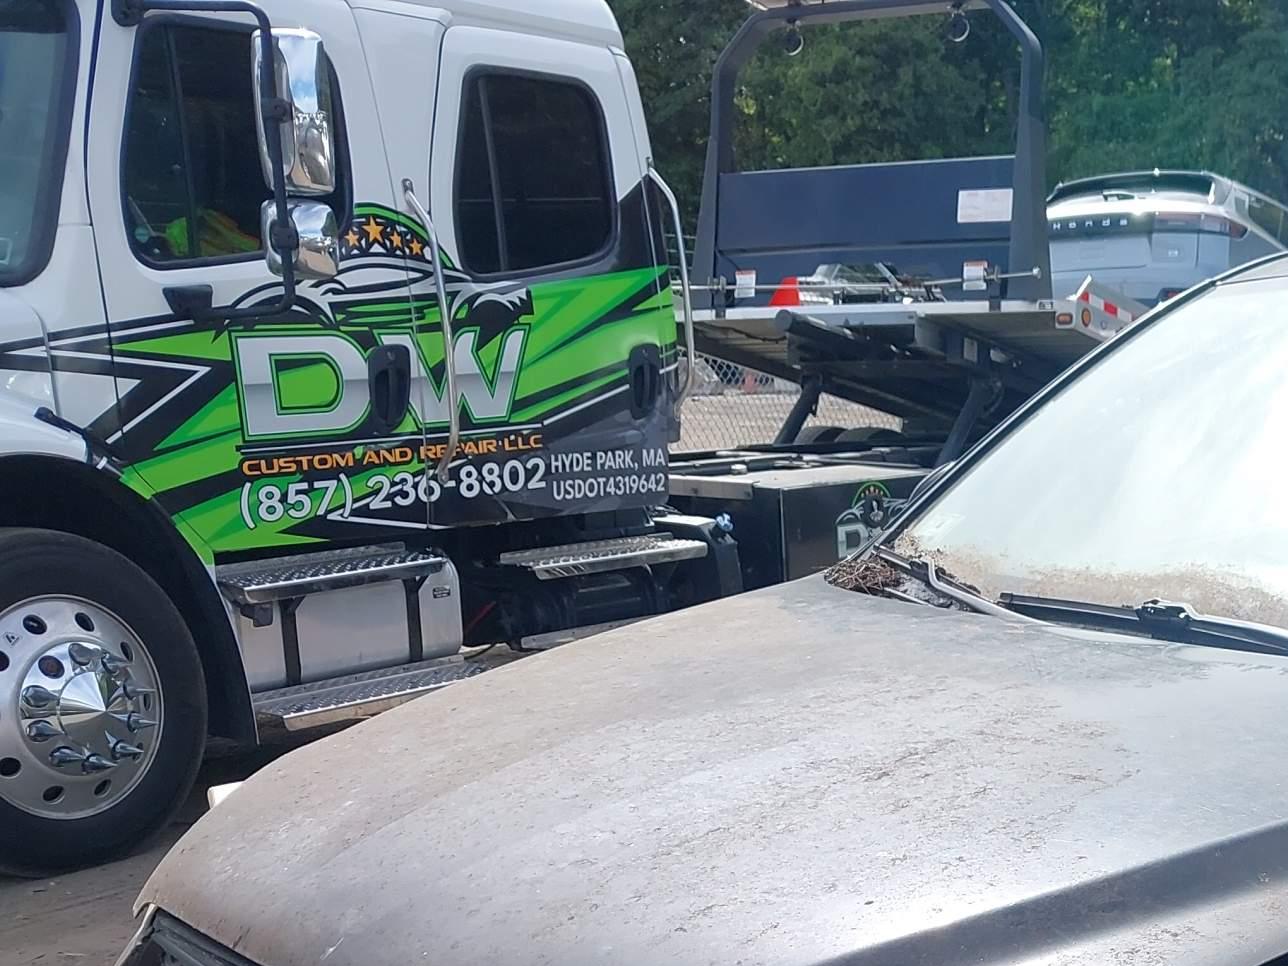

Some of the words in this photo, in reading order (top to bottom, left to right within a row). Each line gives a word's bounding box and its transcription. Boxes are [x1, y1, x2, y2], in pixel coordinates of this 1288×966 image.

[230, 325, 529, 441] DW
[241, 452, 353, 476] CUSTOM
[363, 447, 412, 465] AND
[419, 439, 497, 459] REPAIR
[503, 434, 543, 450] LLC
[551, 452, 592, 474] HYDE
[596, 450, 638, 471] PARK,
[642, 448, 666, 467] MA
[240, 473, 353, 529] (857)
[366, 457, 547, 510] 236-8802
[553, 473, 665, 500] USDOT4319642
